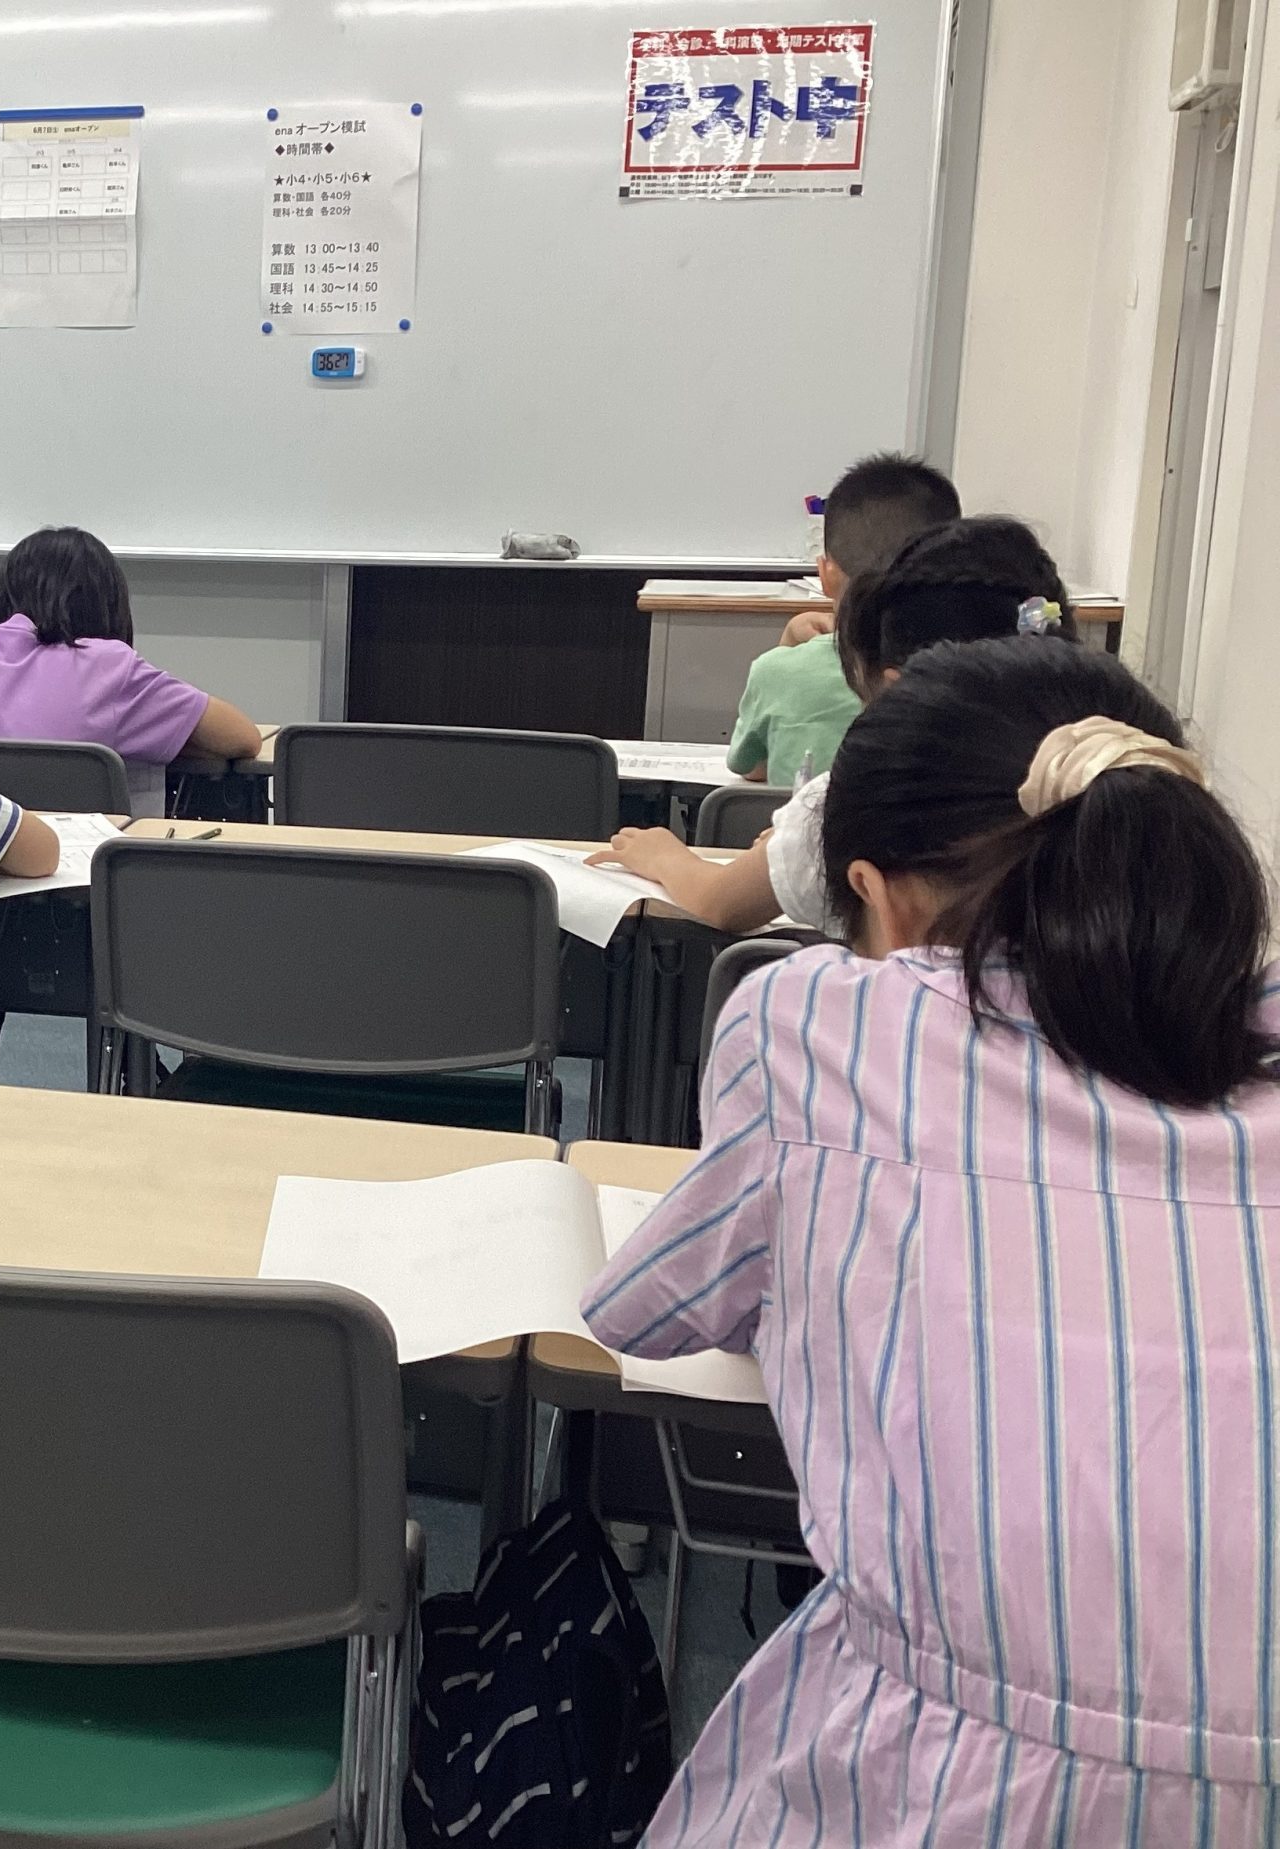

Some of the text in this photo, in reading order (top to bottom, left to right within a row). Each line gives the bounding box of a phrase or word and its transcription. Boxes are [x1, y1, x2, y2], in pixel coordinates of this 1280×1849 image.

[635, 76, 859, 141] テスト中
[274, 120, 366, 136] ena オープン模試
[286, 142, 323, 156] 時間帯
[320, 190, 351, 201] 各40分
[320, 206, 351, 216] 各20分
[271, 243, 295, 256] 算数
[270, 262, 295, 275] 国語
[269, 282, 293, 295] 理科
[268, 302, 293, 315] 社会
